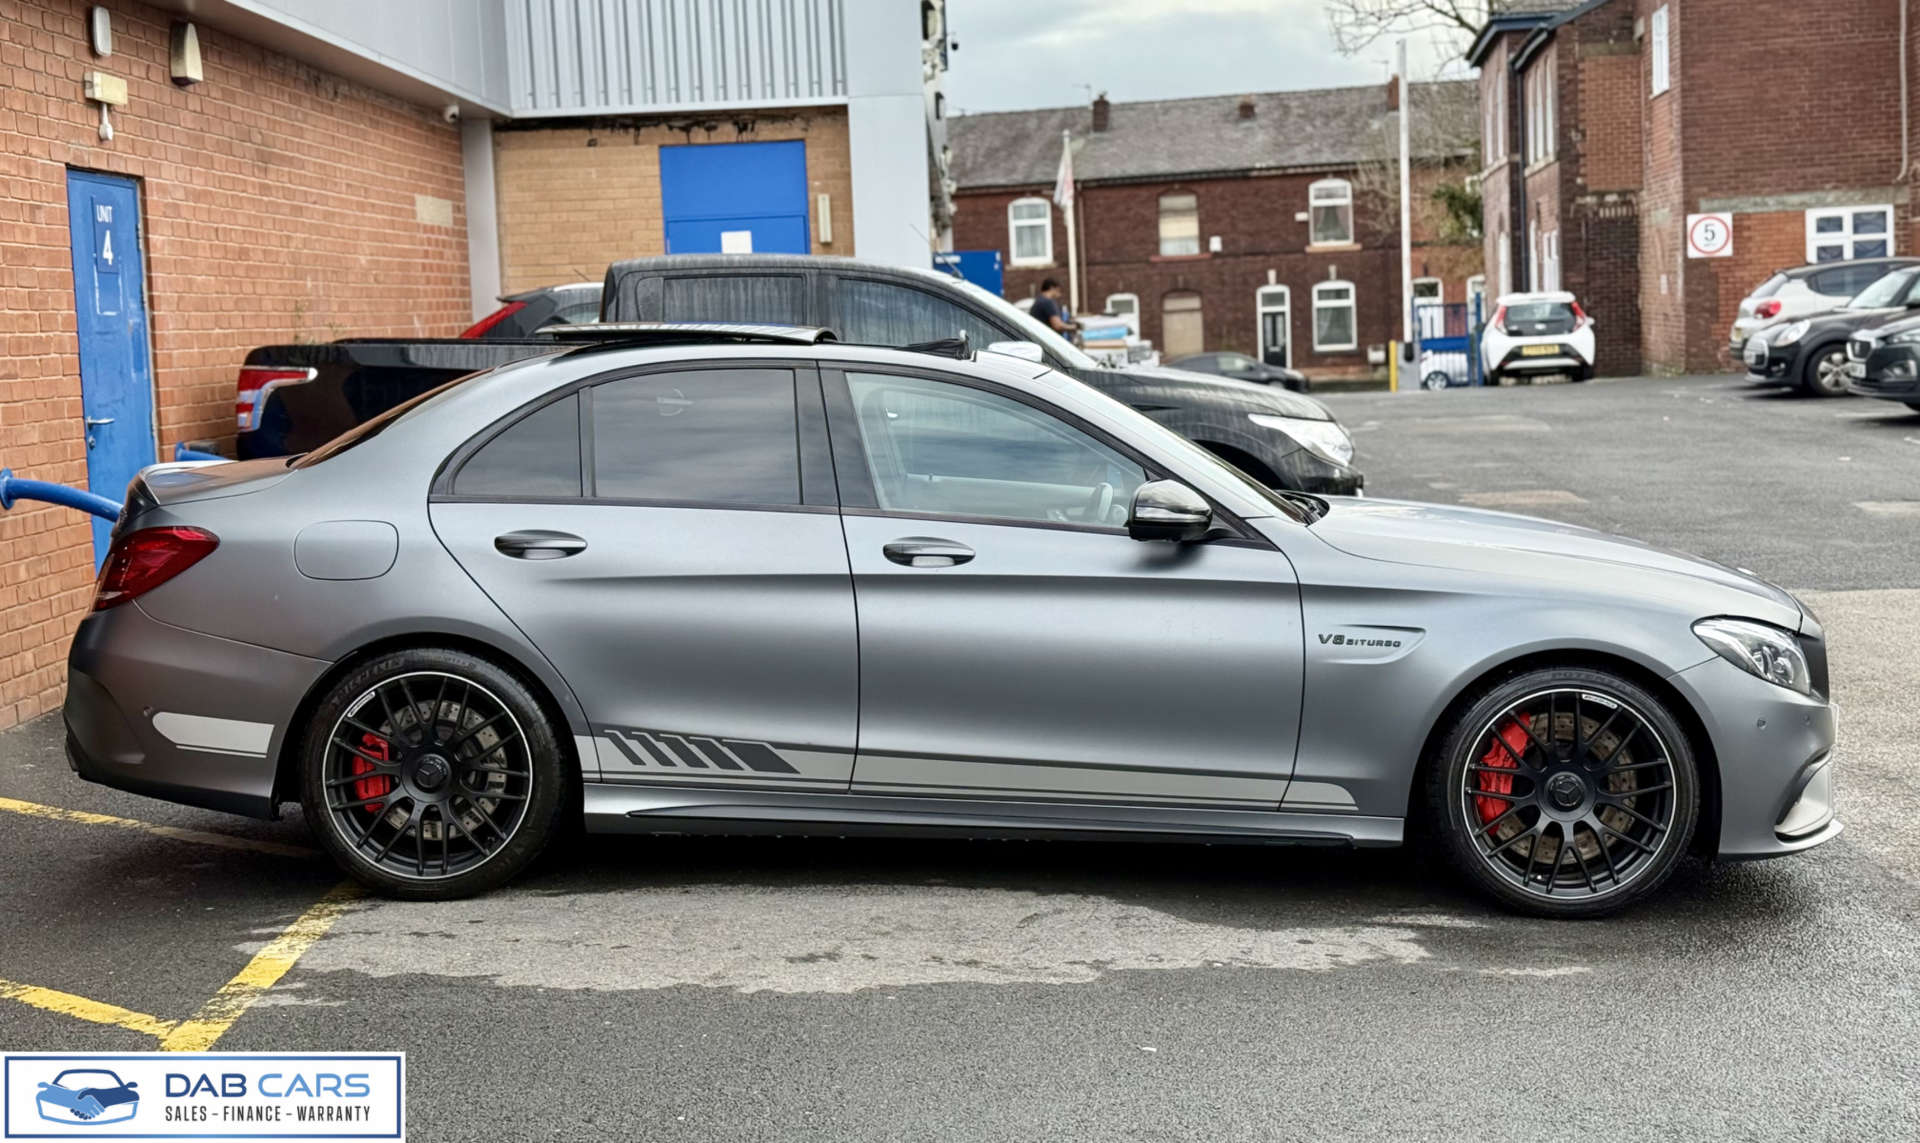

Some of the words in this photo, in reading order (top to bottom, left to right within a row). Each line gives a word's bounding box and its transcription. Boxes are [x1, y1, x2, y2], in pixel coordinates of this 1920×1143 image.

[96, 204, 112, 223] UNIT
[1704, 223, 1716, 241] 5
[103, 229, 113, 265] 4
[1346, 638, 1401, 648] BITURBO
